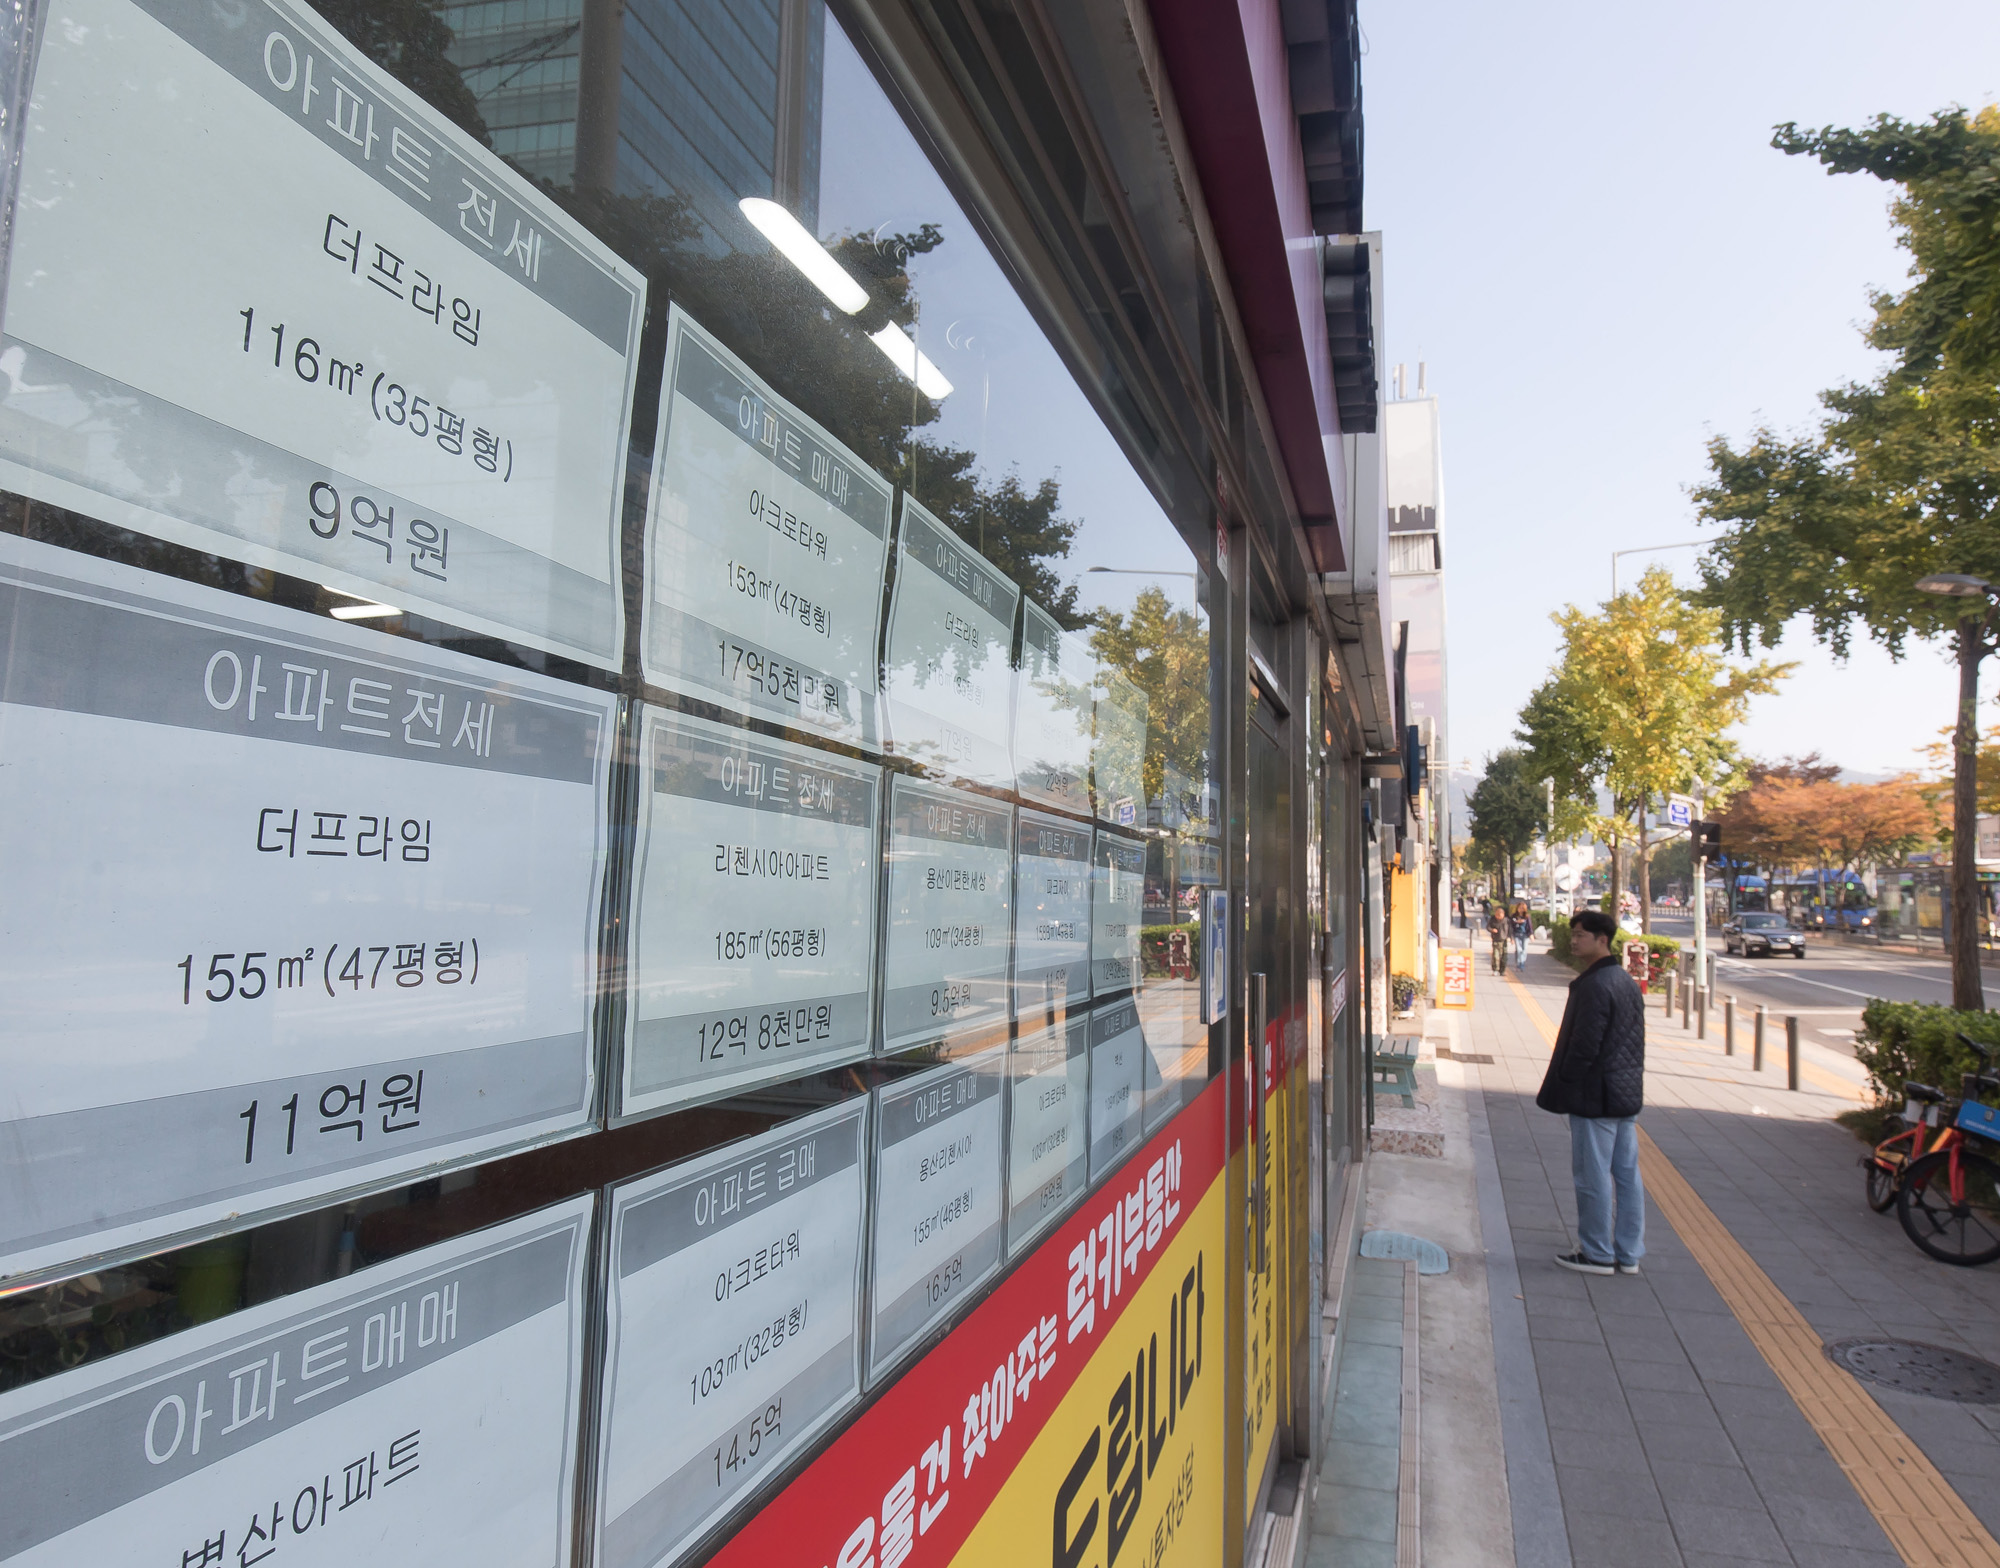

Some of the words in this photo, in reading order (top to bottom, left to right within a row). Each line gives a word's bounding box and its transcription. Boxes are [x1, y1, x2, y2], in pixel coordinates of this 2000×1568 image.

[263, 31, 432, 202] 아파트
[457, 177, 542, 283] 전세
[322, 213, 482, 347] 더프라임
[738, 395, 801, 472] 아파트
[811, 451, 848, 506] 매매
[309, 481, 450, 582] 9억원
[749, 489, 828, 561] 아크로타워
[936, 543, 969, 593] 아파트
[973, 577, 993, 609] 매매
[945, 611, 979, 649] 더프라임
[718, 640, 840, 719] 17억5천만원
[721, 755, 791, 803] 아파트
[799, 774, 835, 815] 전세
[256, 807, 431, 863] 더프라임
[927, 805, 962, 836] 아파트
[966, 812, 987, 841] 전세
[1038, 830, 1060, 852] 아파트
[715, 843, 830, 881] 리첸시아아파트
[931, 983, 971, 1016] 9.5억원
[698, 1015, 748, 1063] 12억
[758, 1003, 832, 1051] 8천만원
[239, 1070, 425, 1164] 11억원
[915, 1083, 952, 1123] 아파트
[956, 1073, 977, 1105] 매매
[694, 1162, 767, 1226] 아파트
[777, 1140, 816, 1192] 급매
[919, 1135, 972, 1182] 용산리첸시아
[715, 1229, 800, 1302] 아크로타워
[926, 1255, 962, 1307] 16.5억
[961, 1313, 1058, 1479] 찾아주는
[1065, 1137, 1183, 1345] 럭키부동산
[714, 1397, 782, 1487] 14.5억
